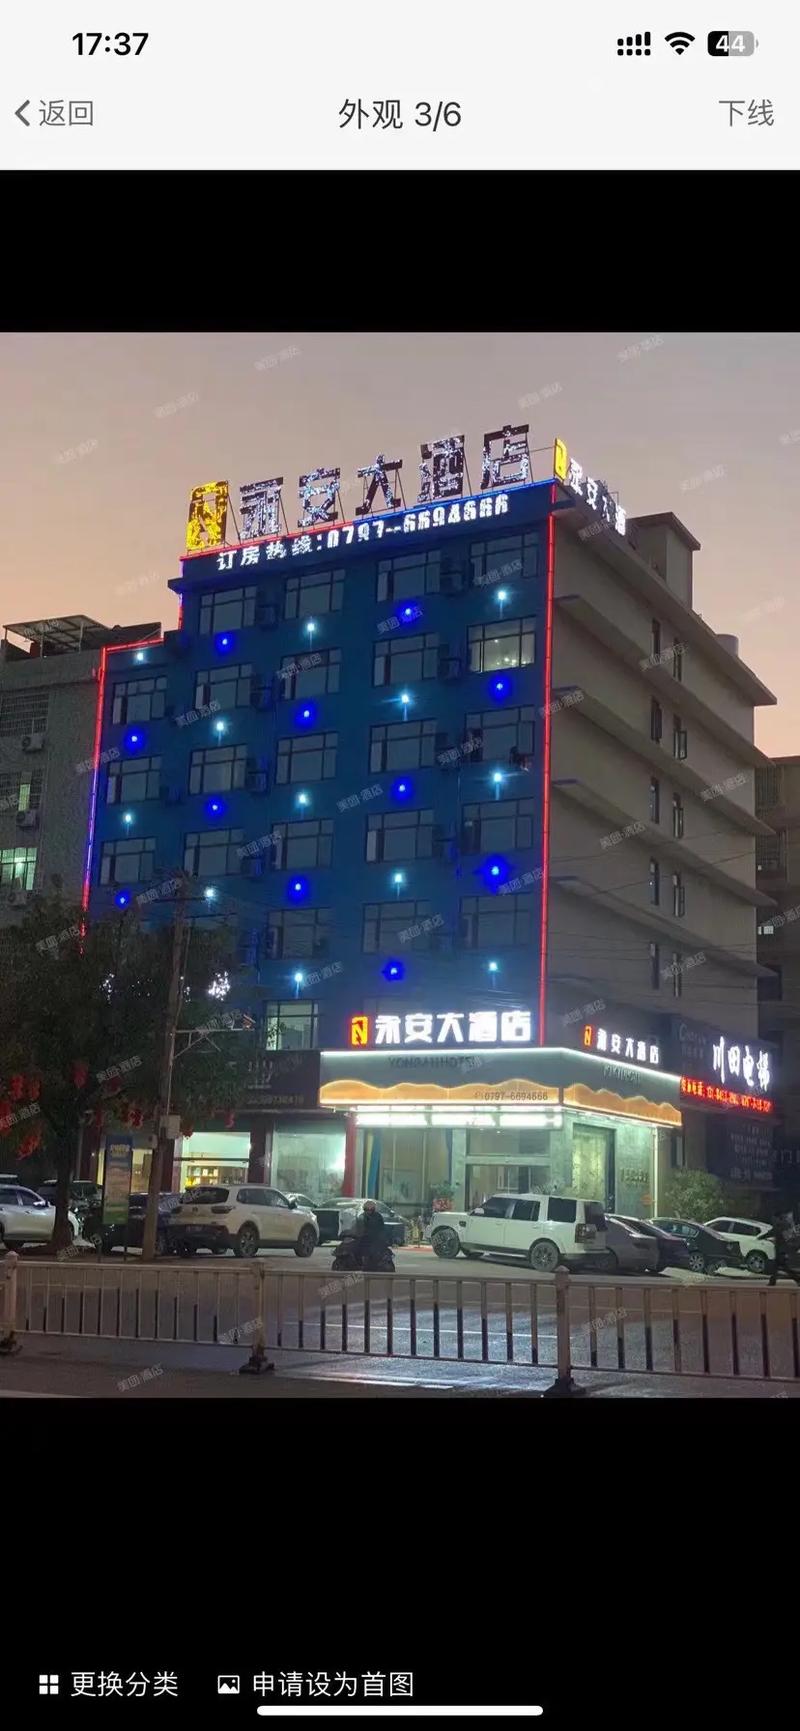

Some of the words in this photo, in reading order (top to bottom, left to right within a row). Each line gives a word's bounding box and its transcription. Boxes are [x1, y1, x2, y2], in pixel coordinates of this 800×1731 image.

[72, 32, 149, 56] 17:37
[714, 34, 747, 53] 44
[39, 100, 93, 126] 返回
[339, 98, 403, 129] 外观
[415, 101, 461, 132] 3/6
[719, 99, 774, 127] 下线
[375, 1011, 532, 1045] 永安大酒店
[71, 1671, 178, 1696] 更换分类
[253, 1671, 413, 1697] 申请设为首图
